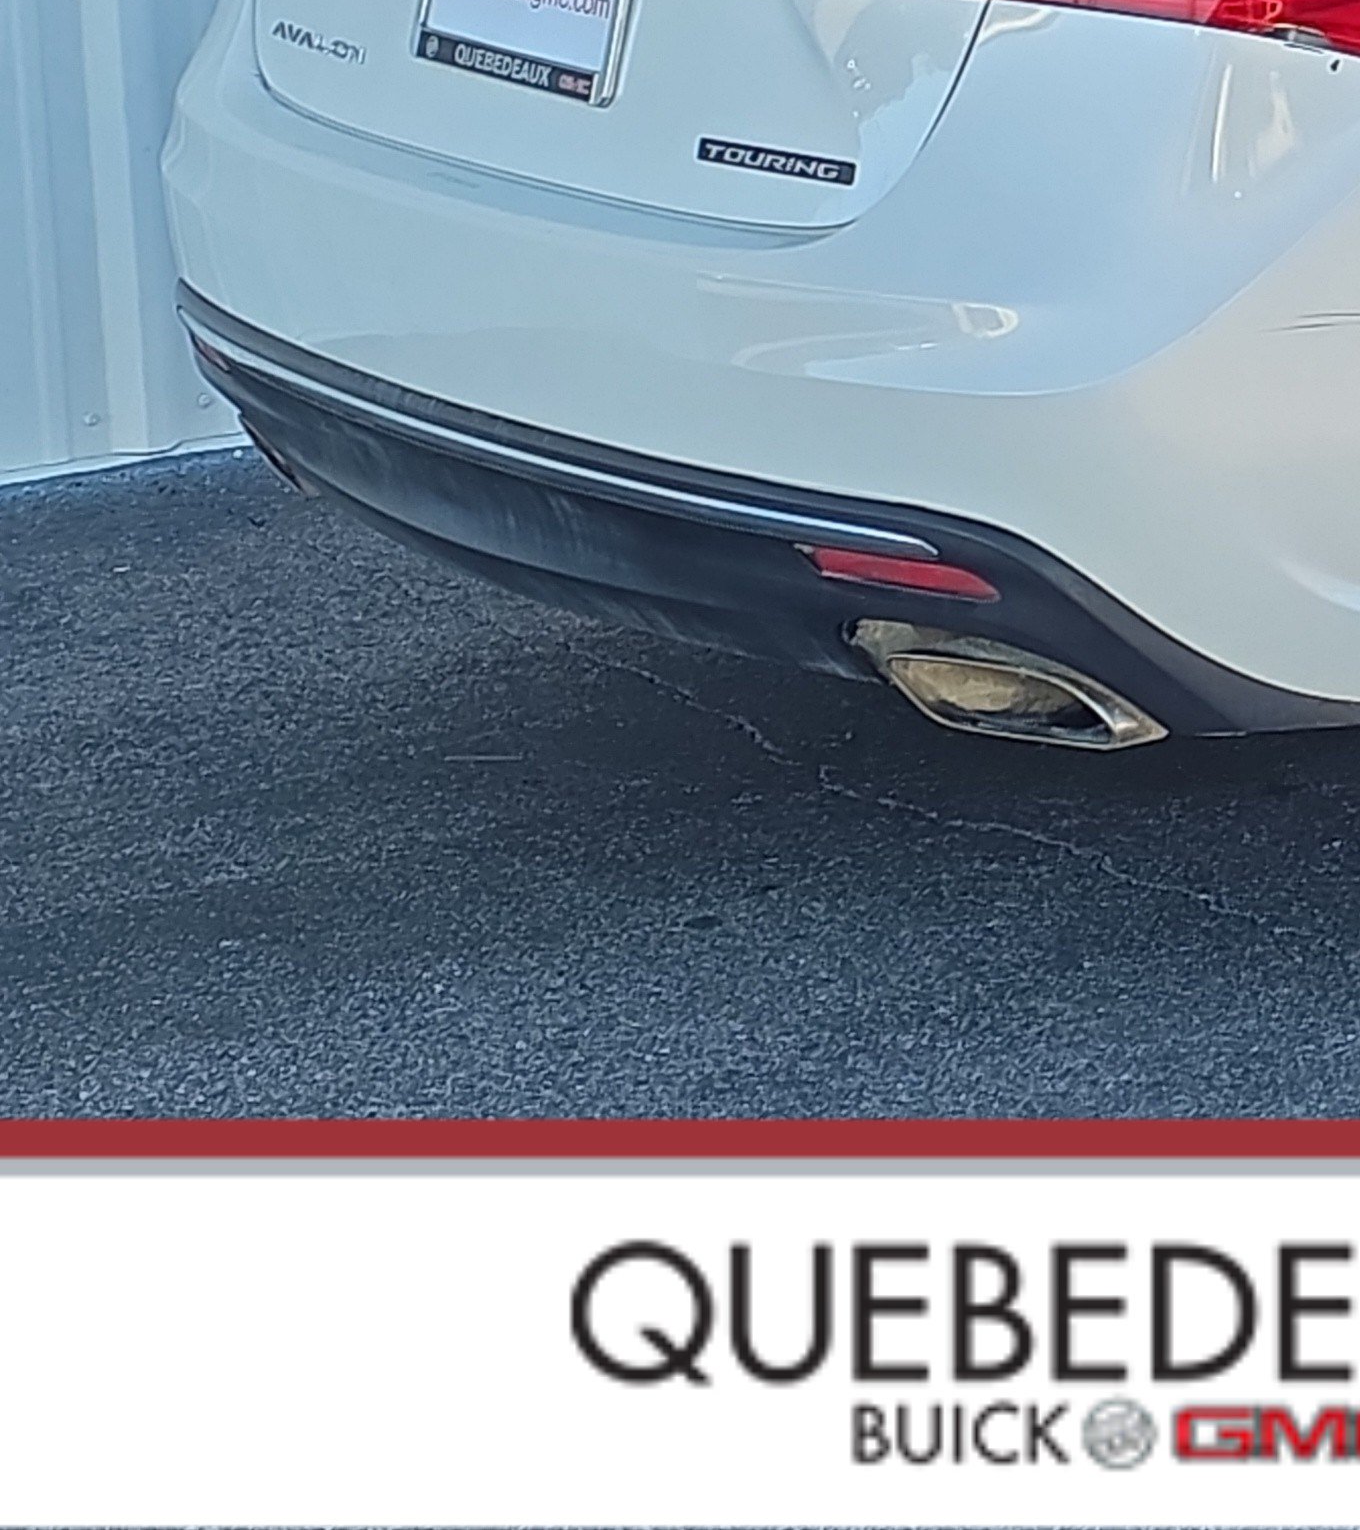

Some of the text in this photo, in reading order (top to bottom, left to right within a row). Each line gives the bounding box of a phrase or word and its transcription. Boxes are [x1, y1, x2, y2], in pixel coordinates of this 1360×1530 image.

[272, 20, 366, 66] AVALON
[453, 43, 552, 88] QUEBEDEAUX
[705, 142, 841, 179] TOURING
